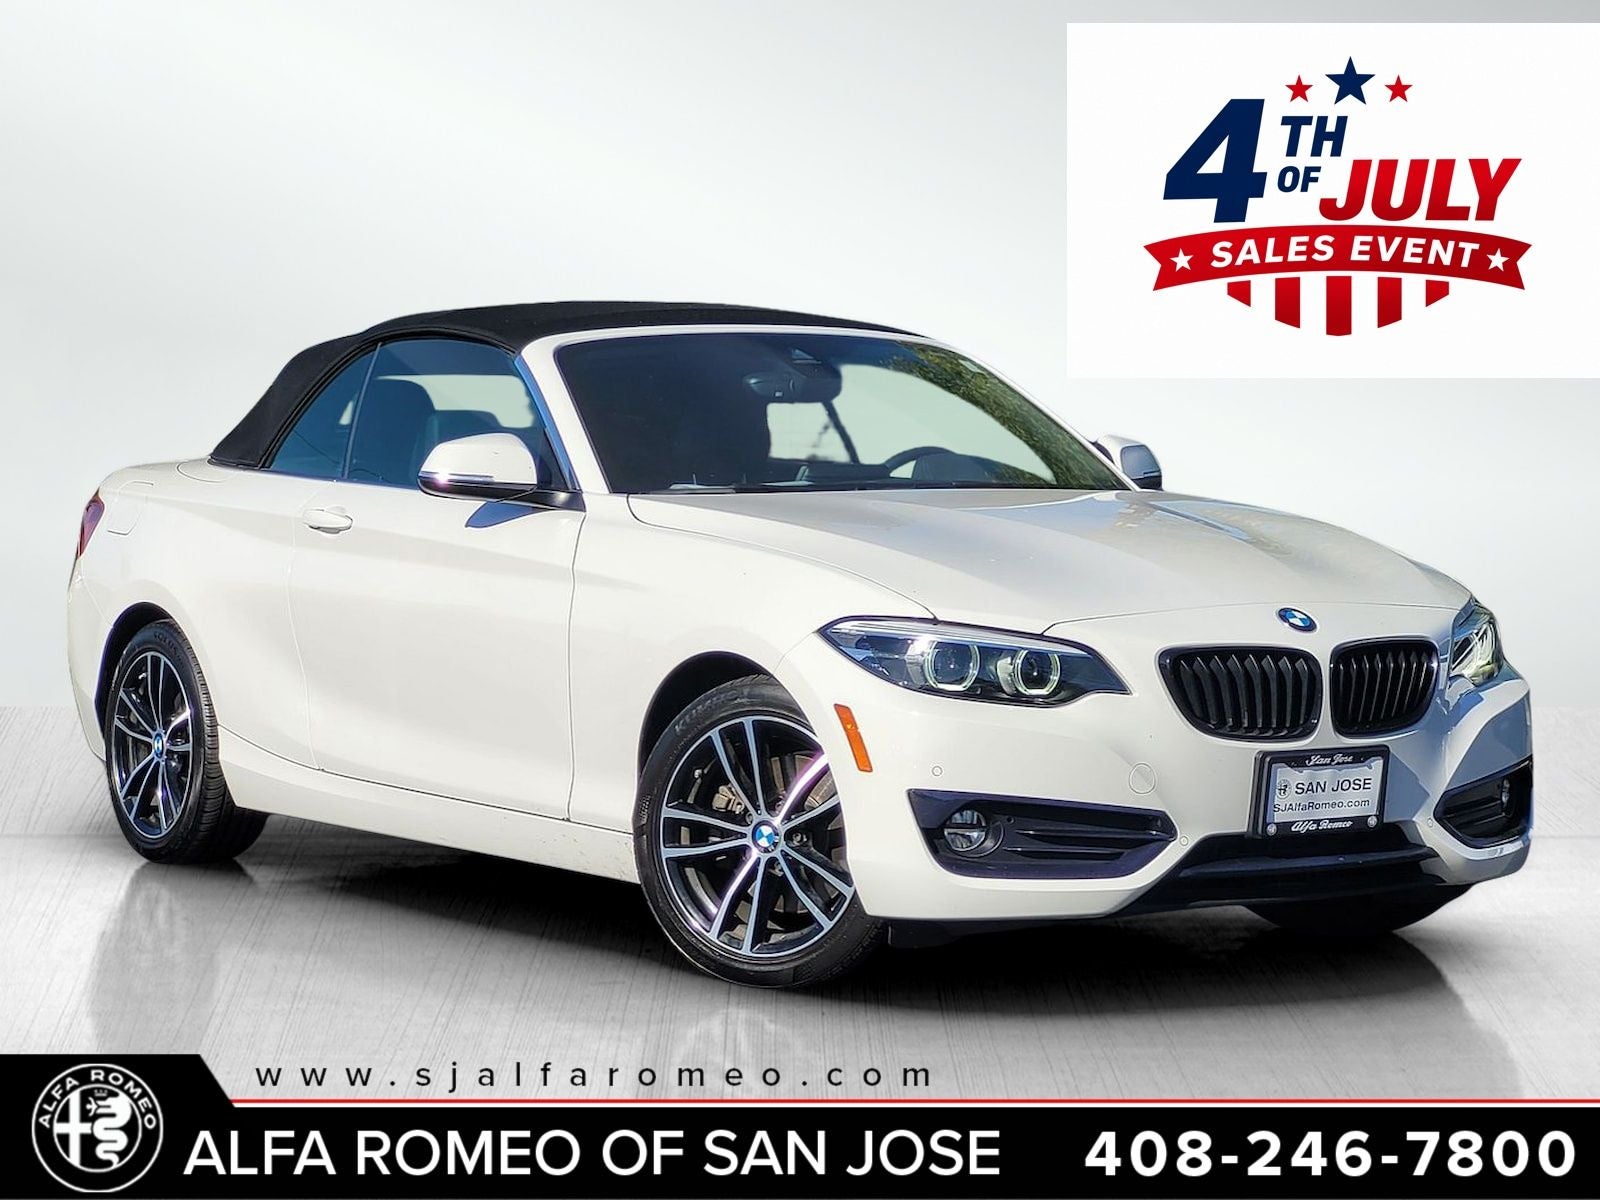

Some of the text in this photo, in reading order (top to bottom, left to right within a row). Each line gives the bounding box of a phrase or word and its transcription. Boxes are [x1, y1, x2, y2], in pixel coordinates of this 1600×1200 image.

[1295, 781, 1327, 795] SAN
[1332, 778, 1372, 792] JOSE
[1273, 799, 1370, 813] SJAlfaRomeo.com
[1291, 820, 1318, 834] Alfa
